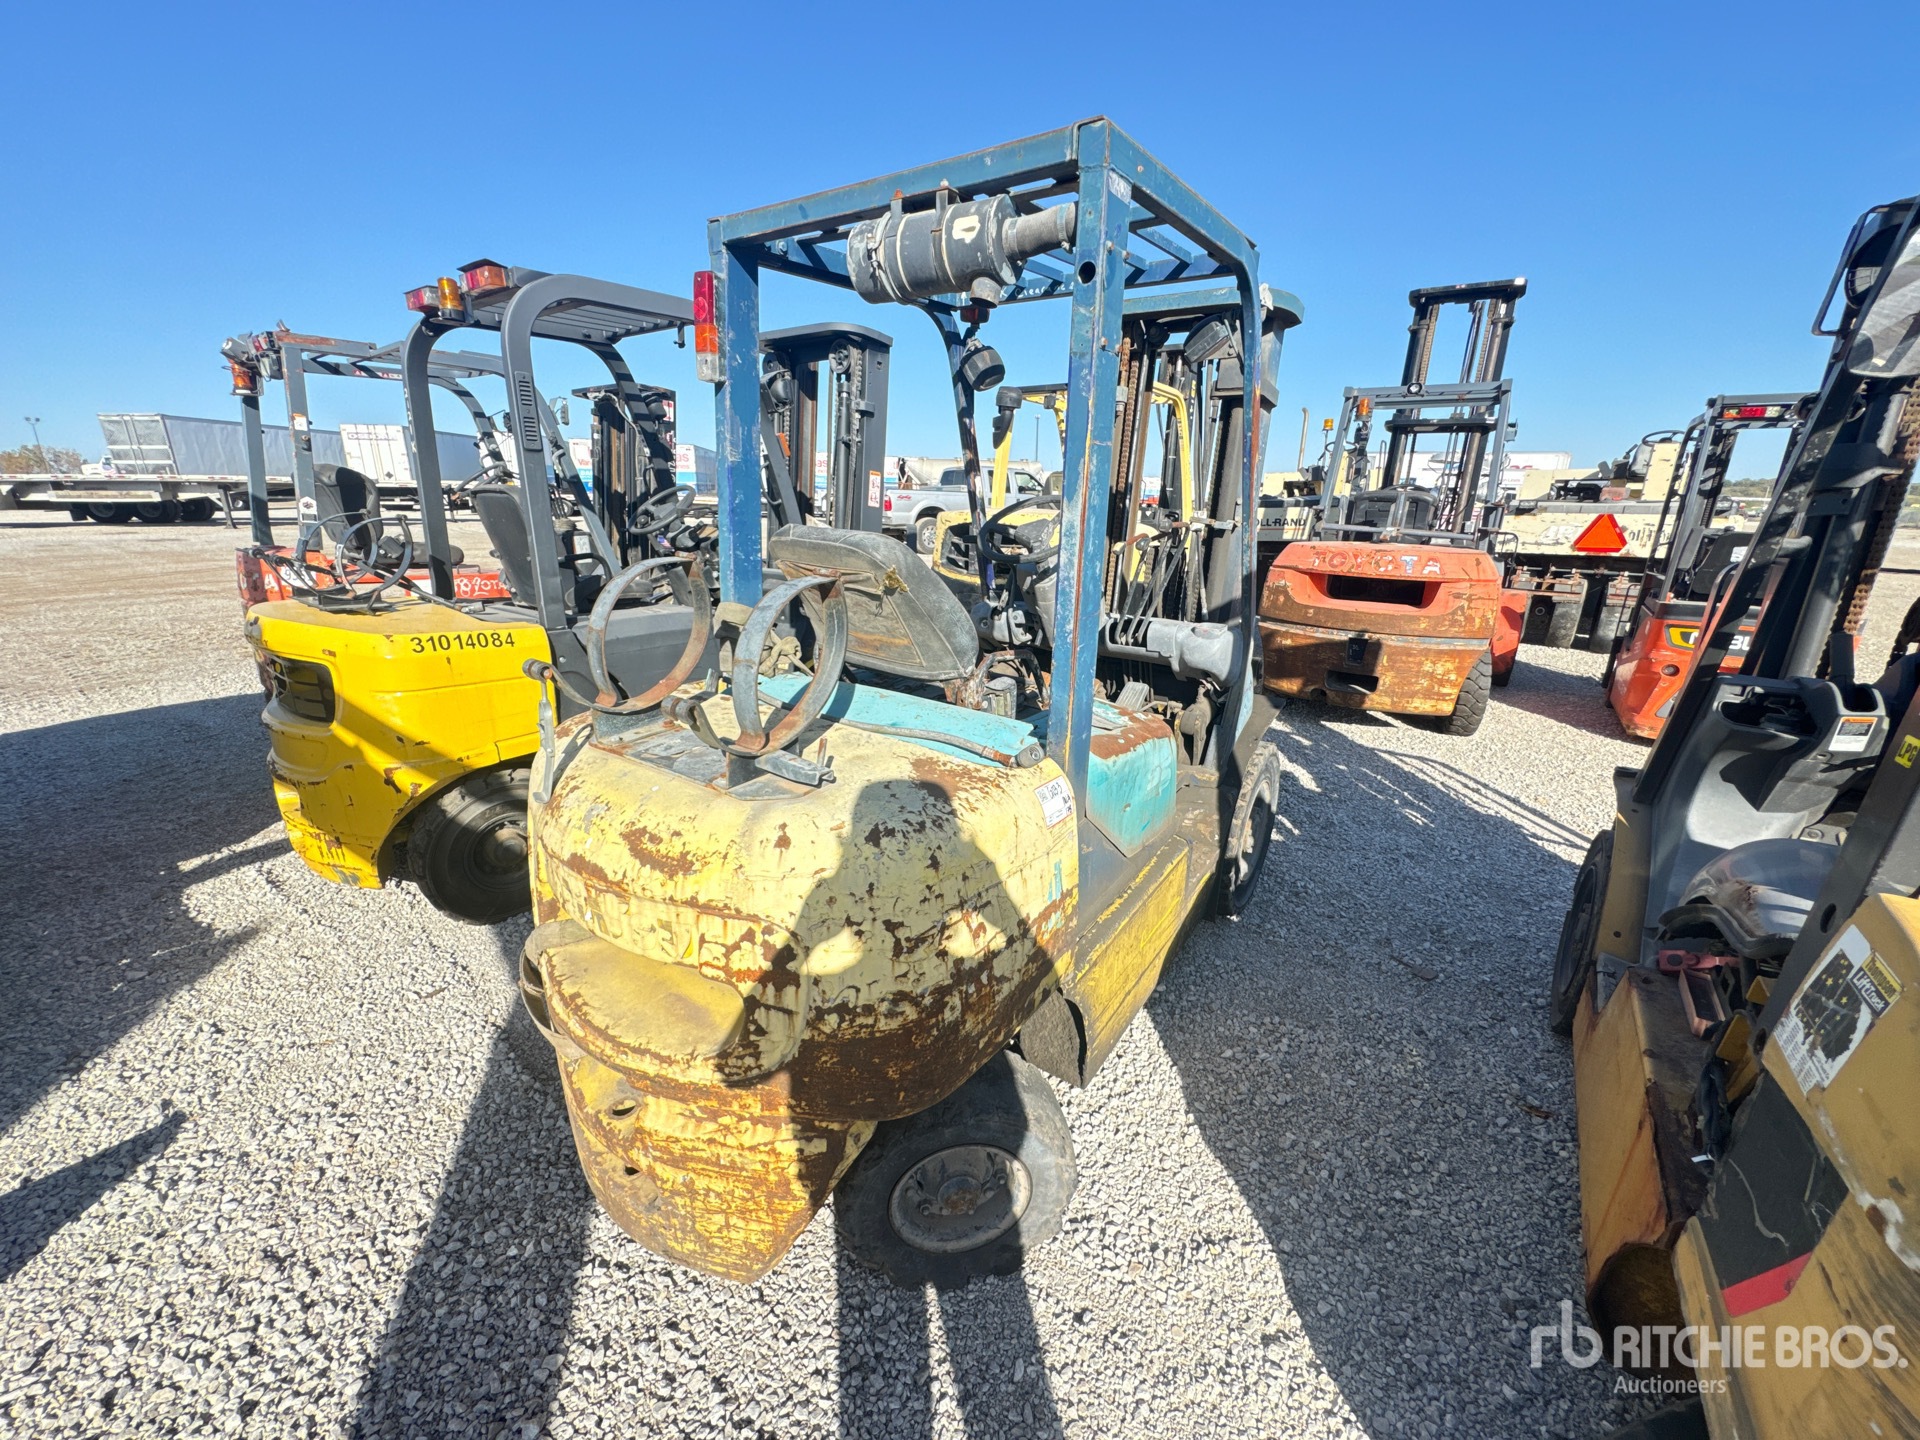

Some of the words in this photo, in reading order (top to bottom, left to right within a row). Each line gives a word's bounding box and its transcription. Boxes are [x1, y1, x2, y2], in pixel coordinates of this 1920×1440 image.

[1257, 518, 1306, 527] LL-RAND
[1313, 550, 1446, 575] TOYOTA
[410, 632, 515, 653] 31014084
[1898, 740, 1919, 762] LPG
